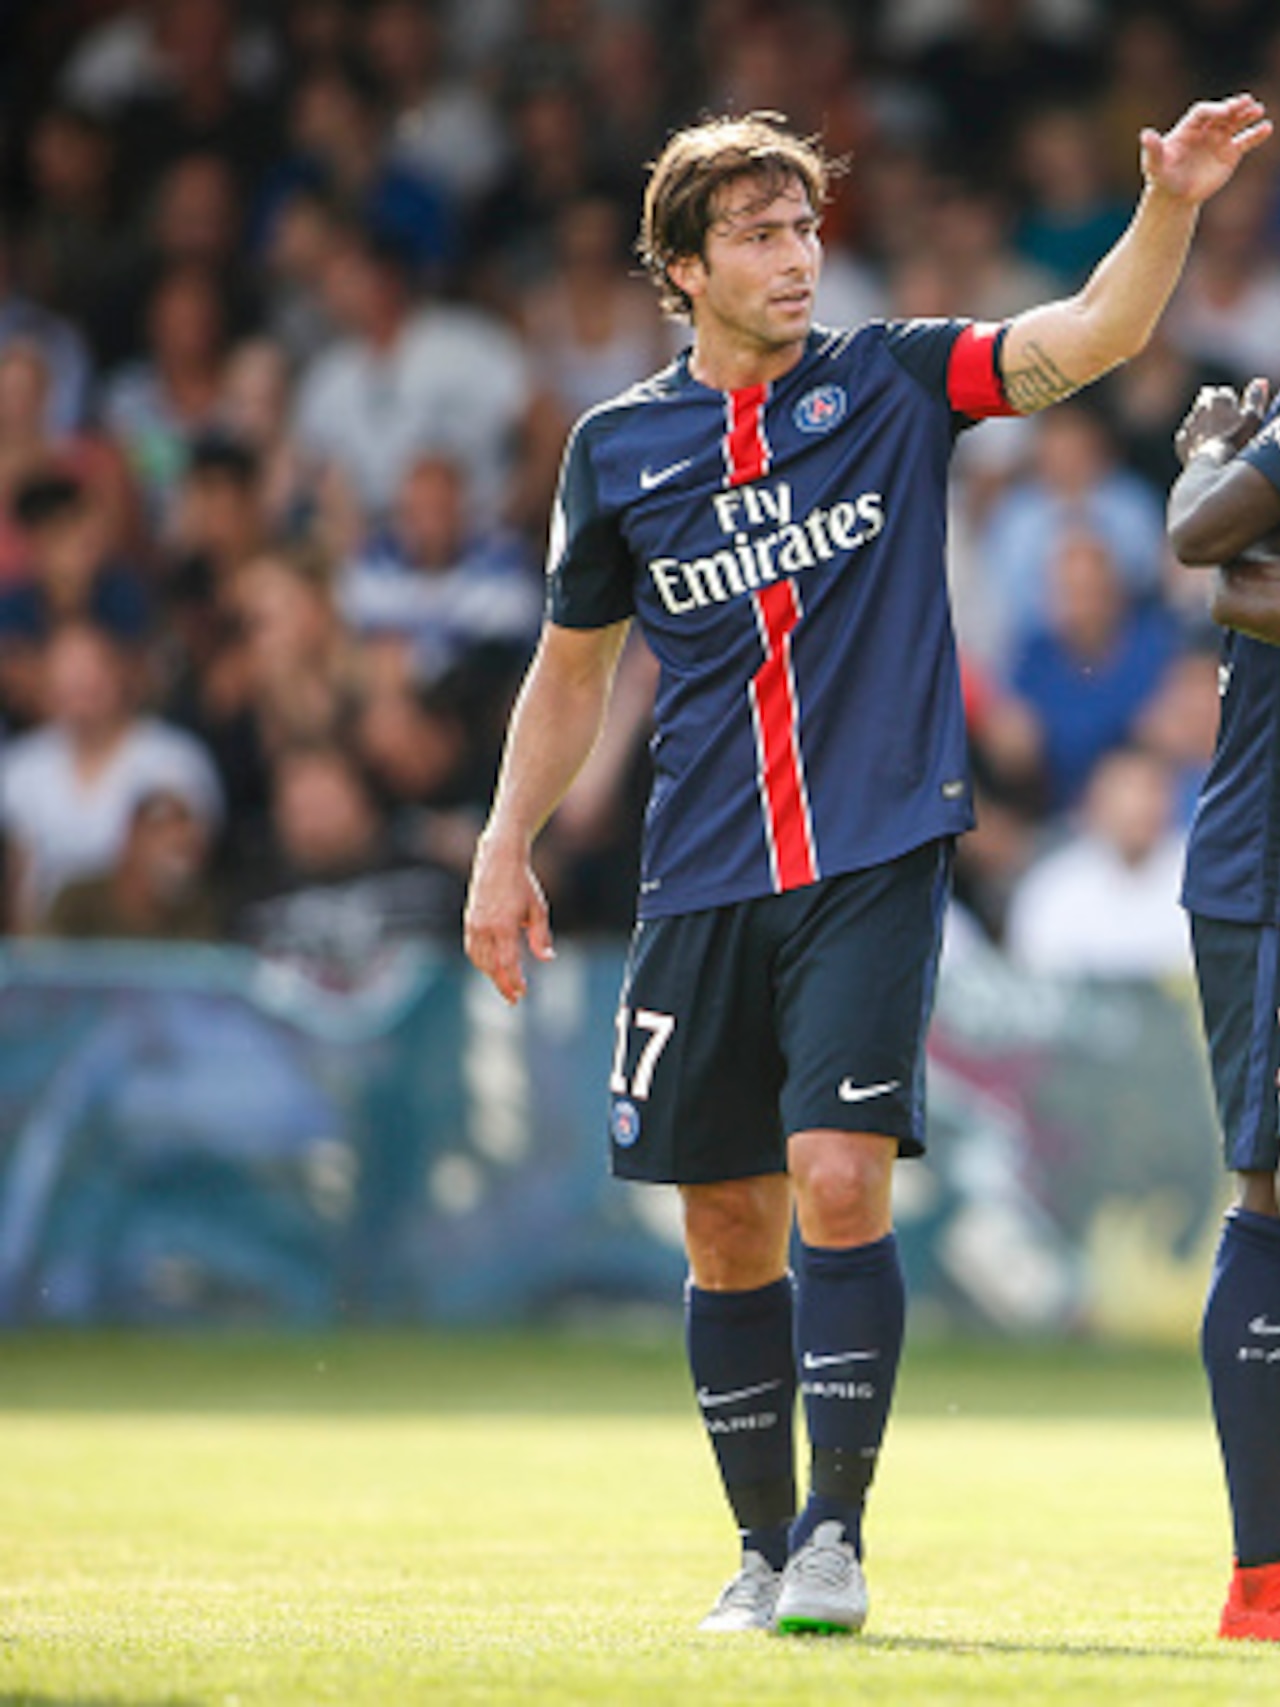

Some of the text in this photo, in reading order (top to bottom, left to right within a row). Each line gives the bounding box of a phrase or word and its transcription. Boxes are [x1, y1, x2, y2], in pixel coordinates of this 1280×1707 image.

[648, 492, 884, 615] Emirates
[712, 482, 792, 534] Fly
[610, 1005, 676, 1101] 17
